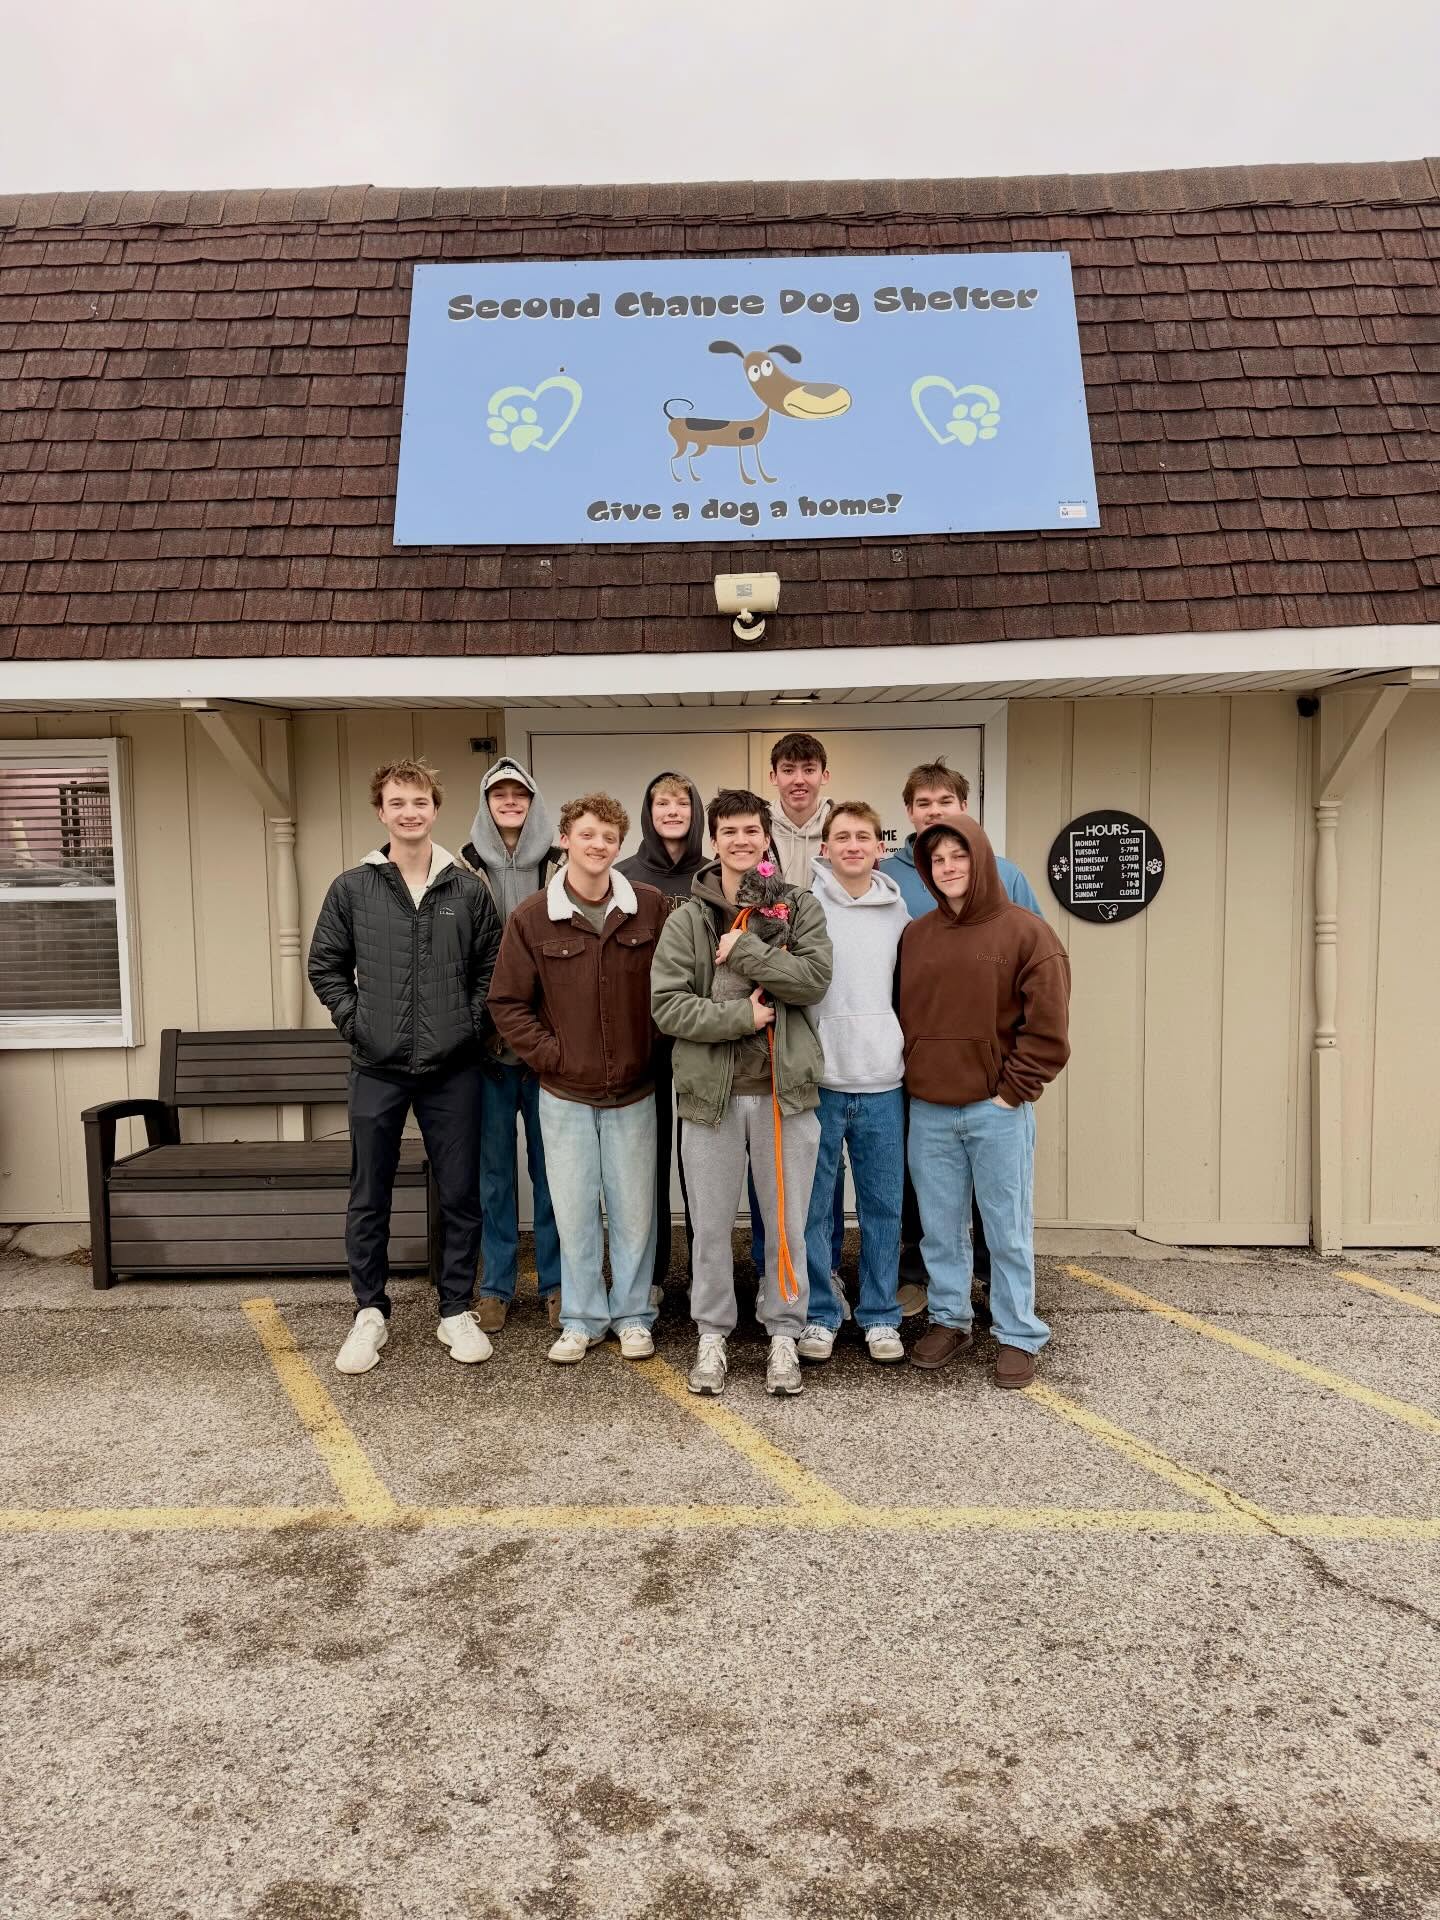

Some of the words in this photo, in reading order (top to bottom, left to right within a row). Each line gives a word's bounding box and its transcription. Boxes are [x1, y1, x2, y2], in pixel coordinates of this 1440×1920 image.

[448, 292, 601, 321] Second
[614, 291, 766, 318] Chance
[779, 289, 861, 323] Dog
[873, 286, 1039, 313] Shelter
[586, 500, 662, 522] Give
[672, 500, 691, 520] a
[700, 498, 760, 527] dog
[769, 500, 788, 518] a
[798, 493, 903, 516] home!
[1086, 824, 1129, 836] HOURS
